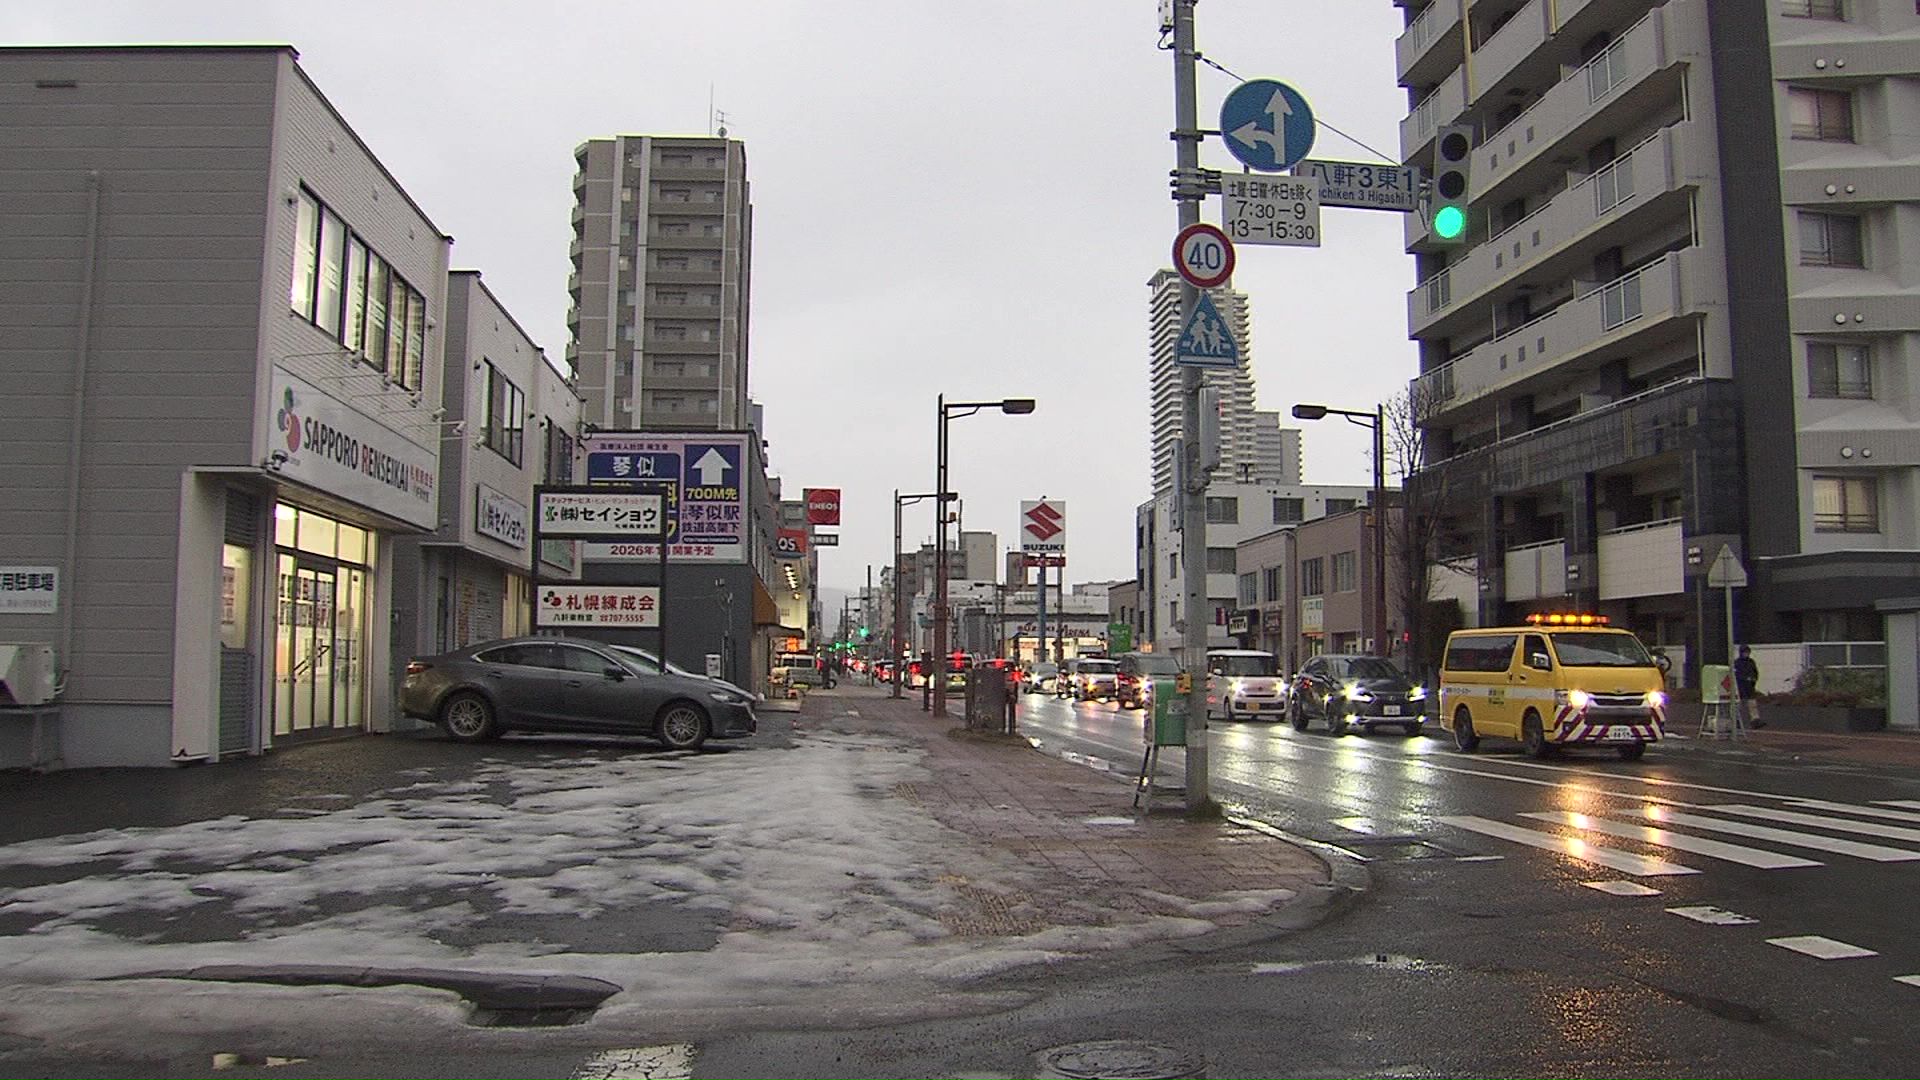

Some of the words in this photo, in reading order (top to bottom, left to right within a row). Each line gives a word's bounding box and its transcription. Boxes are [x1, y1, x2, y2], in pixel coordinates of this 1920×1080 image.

[1318, 187, 1354, 200] chiken
[1358, 191, 1365, 200] 3
[1368, 190, 1405, 204] Higashi
[1408, 194, 1413, 204] 1
[1188, 242, 1221, 270] 40
[303, 416, 358, 470] SAPPORO
[361, 444, 408, 492] RENSEIKAI
[612, 456, 655, 477] 琴似
[685, 488, 737, 500] 700M先
[566, 595, 655, 610] 札幌練成会
